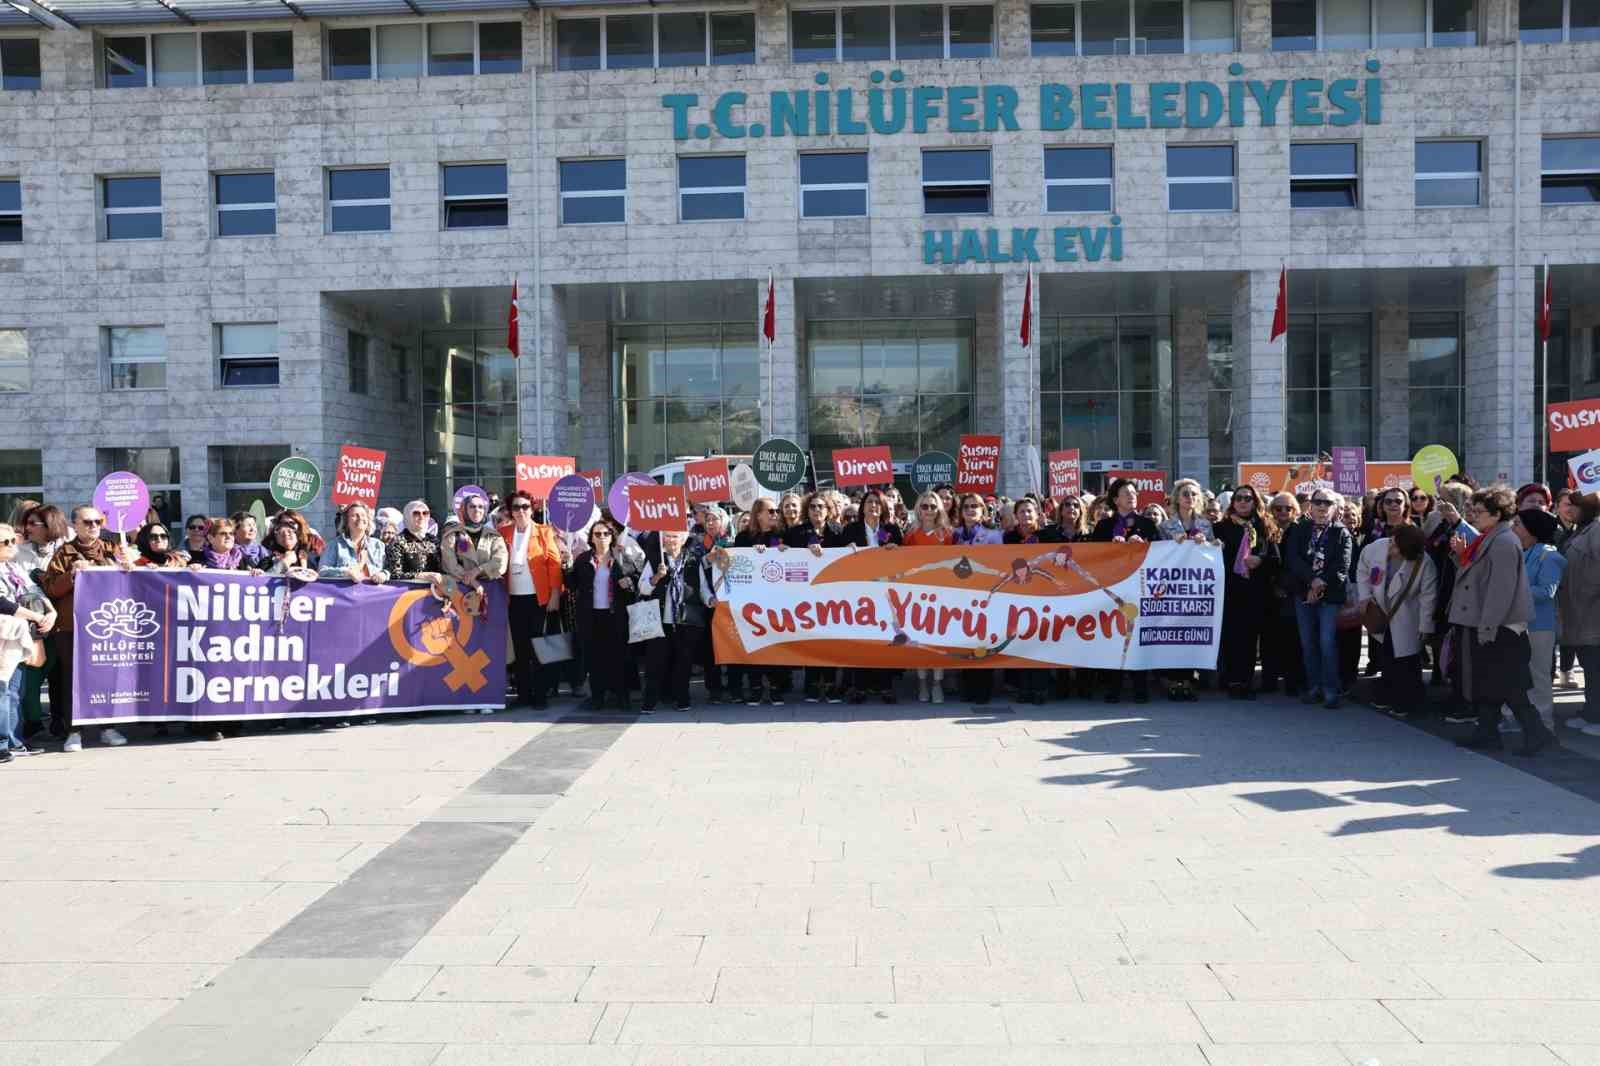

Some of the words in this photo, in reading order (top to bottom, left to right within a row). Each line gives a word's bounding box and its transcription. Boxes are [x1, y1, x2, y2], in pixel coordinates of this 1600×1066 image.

[1040, 59, 1382, 131] BELEDİYESİ
[923, 228, 1041, 264] HALK
[1054, 215, 1123, 262] EVİ
[961, 445, 998, 457] Susma
[341, 455, 381, 471] Susma
[837, 459, 888, 477] Diren
[963, 457, 994, 470] Yürü
[342, 469, 376, 484] Yürü
[517, 463, 574, 480] Susma
[959, 471, 993, 484] Diren
[336, 481, 375, 497] Diren
[688, 474, 727, 493] Diren
[633, 496, 680, 520] Yürü
[1146, 567, 1216, 581] KADINA
[176, 583, 335, 622] Nilüfer
[1182, 600, 1213, 615] KARŞI
[1006, 603, 1128, 643] Diren
[176, 624, 304, 662] Kadın
[1141, 628, 1183, 642] MÜCADELE
[1184, 628, 1210, 642] GÜNÜ
[91, 640, 155, 652] NİLÜFER
[91, 652, 154, 662] BELEDİYESİ
[176, 661, 400, 703] Dernekleri
